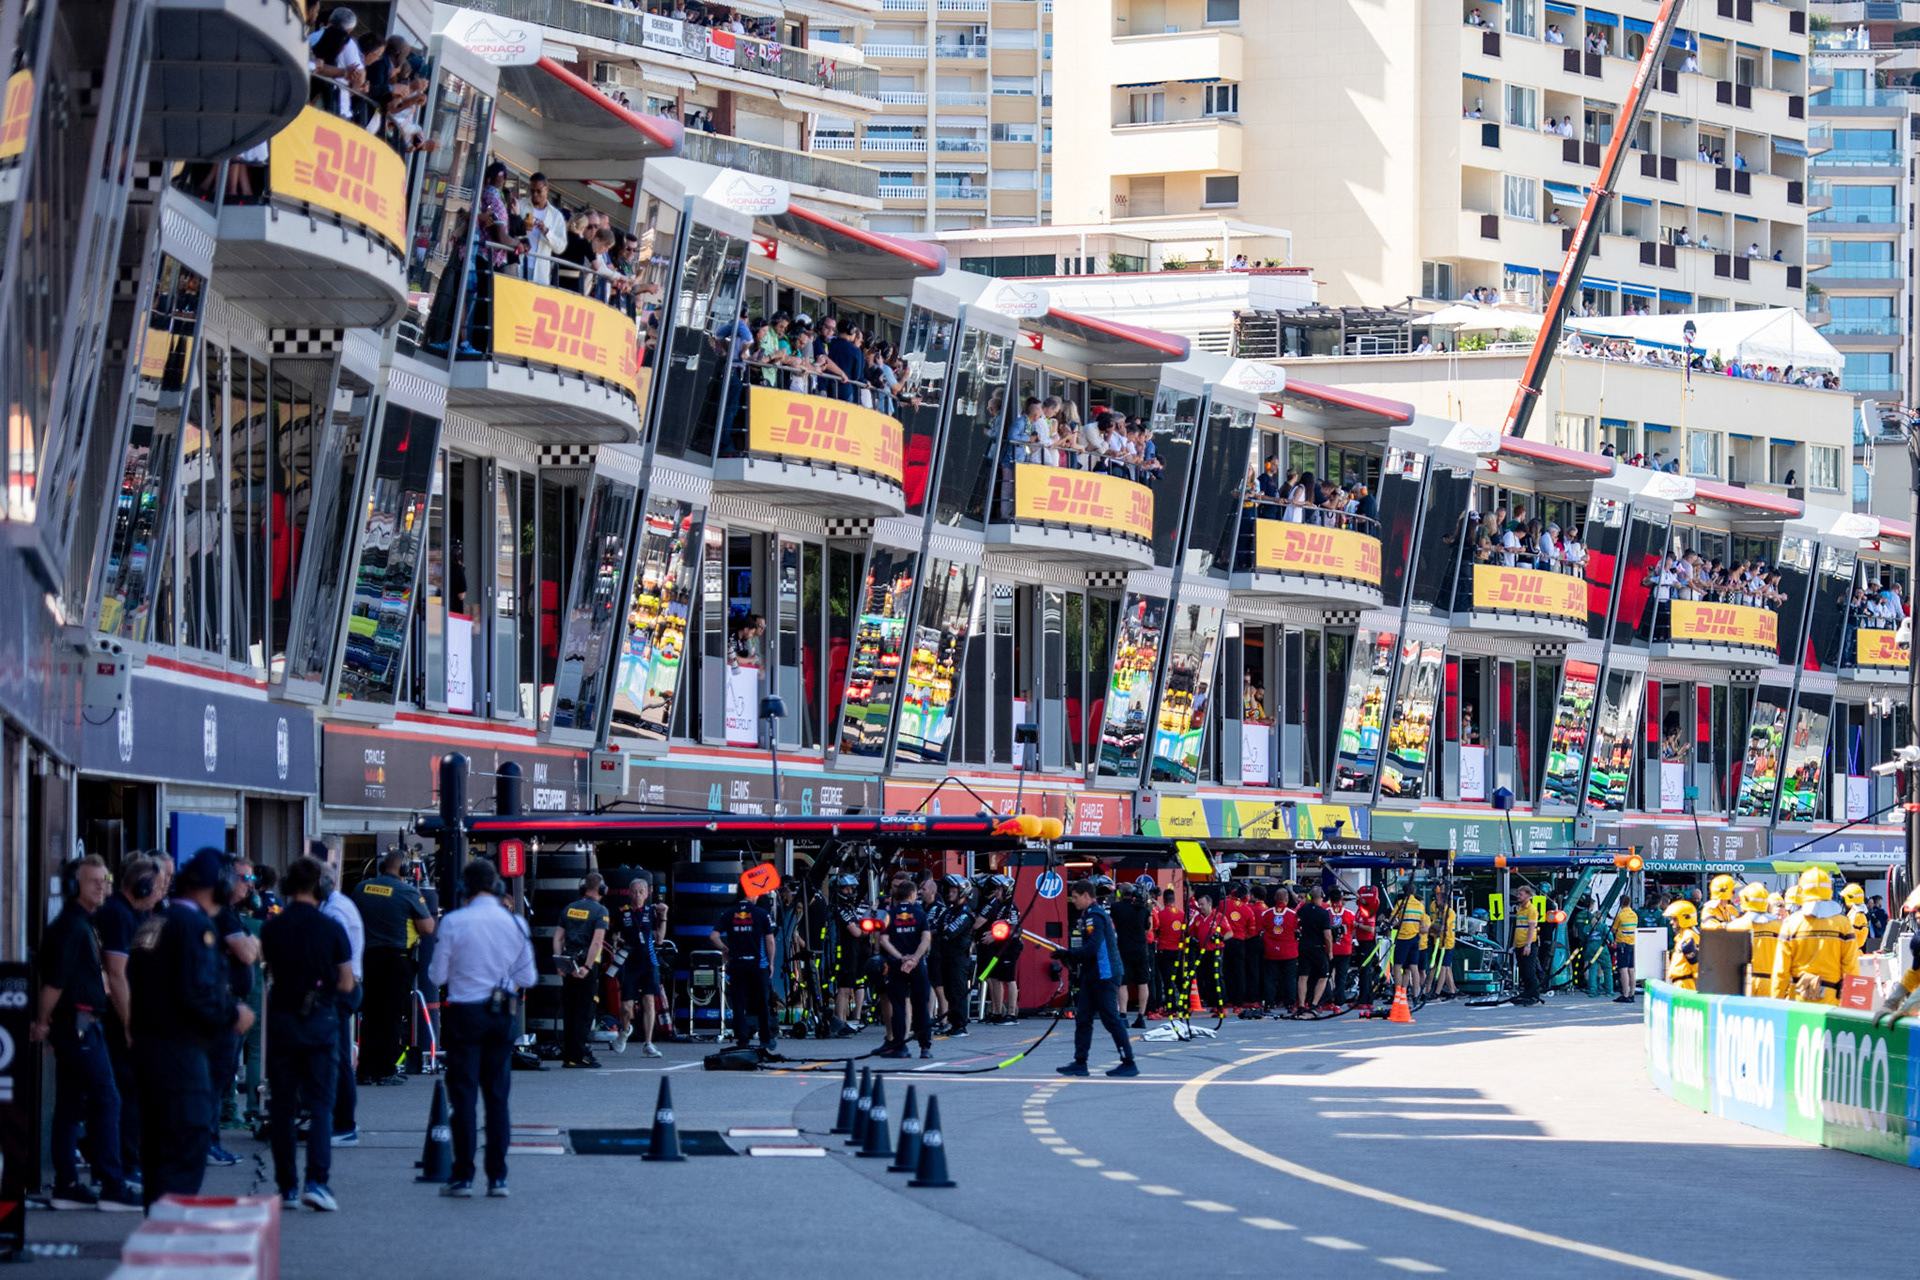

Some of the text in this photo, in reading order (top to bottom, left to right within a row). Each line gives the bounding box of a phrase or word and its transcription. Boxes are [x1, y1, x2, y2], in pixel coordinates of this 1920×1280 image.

[464, 45, 526, 53] MONACO
[715, 47, 730, 61] LEC
[312, 125, 380, 213] DHL
[531, 296, 597, 361] DHL
[785, 402, 851, 453] DHL
[881, 424, 902, 472] DH
[1047, 475, 1105, 517] DHL
[1284, 530, 1336, 566] DHL
[1499, 573, 1546, 605] DHL
[1695, 608, 1738, 636] DHL
[364, 749, 385, 764] ORACLE
[534, 762, 548, 784] MAX
[730, 779, 750, 799] LEWIS
[820, 786, 843, 805] GEORGE
[533, 788, 567, 810] VERSTAPPEN
[708, 783, 722, 811] 44
[801, 788, 813, 816] 63
[1080, 802, 1104, 819] CHARLES
[1169, 816, 1193, 826] McLaren
[1463, 825, 1479, 838] LANCE
[1529, 826, 1553, 840] FERNANDO
[1463, 840, 1480, 852] STROLL
[1663, 834, 1679, 846] PIERRE
[1724, 837, 1743, 848] ESTEBAN
[1663, 848, 1678, 859] GASLY
[1724, 849, 1737, 860] OCON
[1641, 863, 1745, 872] ASTON MARTIN aramco
[366, 886, 390, 895] PIRELLI
[1795, 1024, 1889, 1136] aramco
[842, 1088, 859, 1099] FIA
[657, 1111, 674, 1121] FIA
[871, 1108, 888, 1119] FIA
[903, 1120, 920, 1131] FIA
[432, 1128, 450, 1140] FIA
[923, 1133, 942, 1144] FIA
